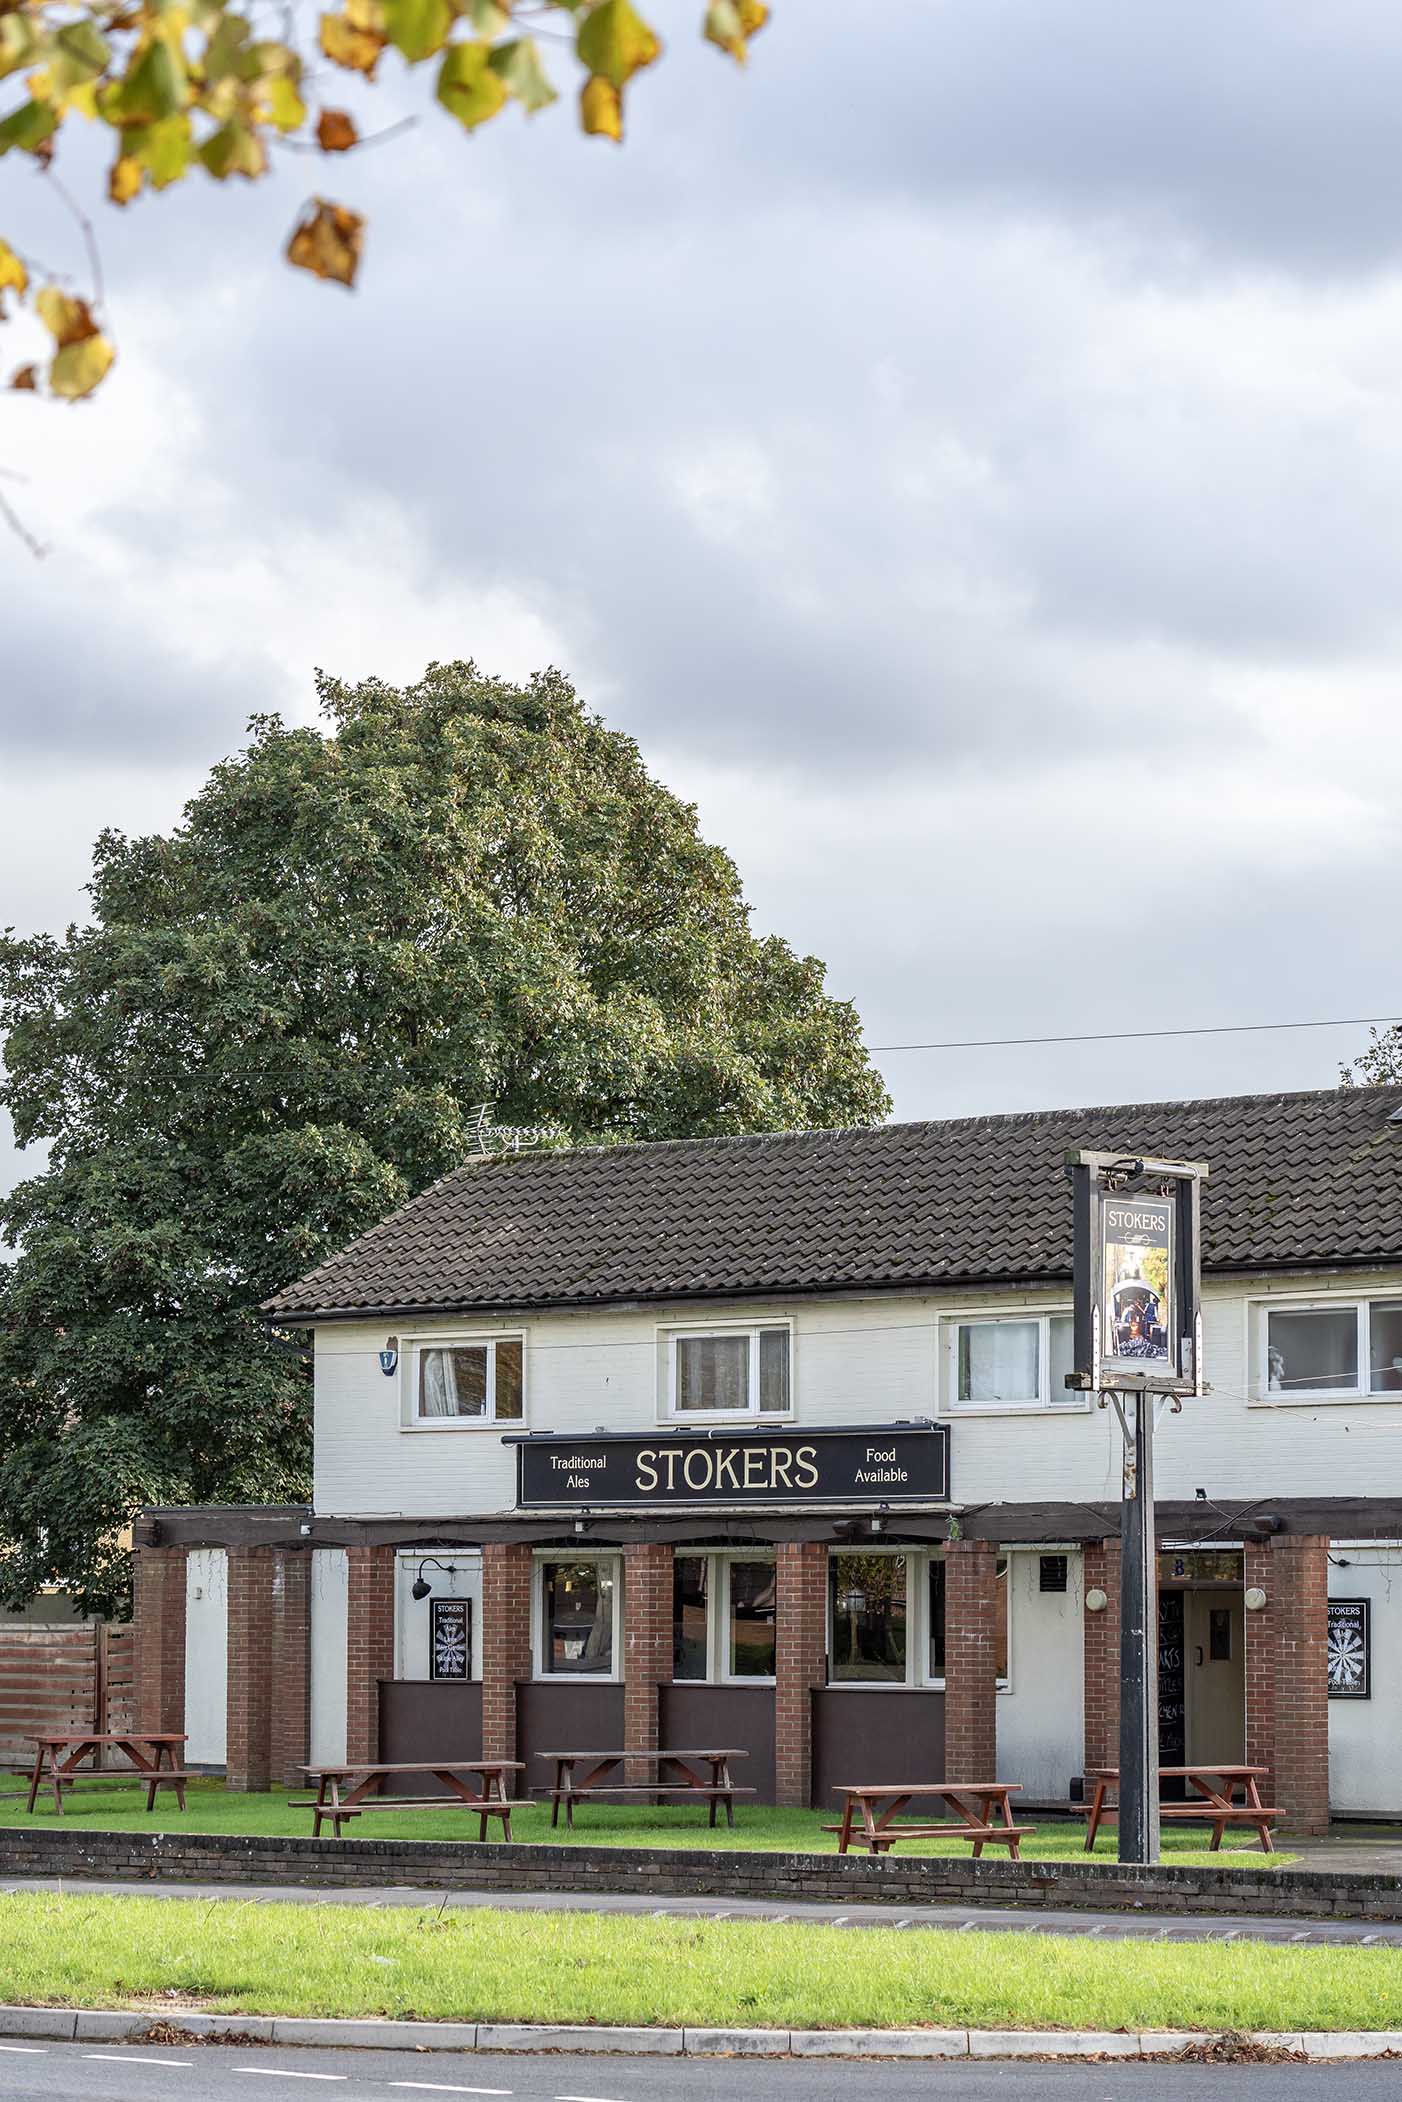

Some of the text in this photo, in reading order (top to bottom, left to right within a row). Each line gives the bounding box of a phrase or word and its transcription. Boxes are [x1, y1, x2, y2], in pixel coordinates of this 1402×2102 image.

[1108, 1210, 1166, 1232] STOKERS
[550, 1455, 607, 1470] Traditional
[866, 1449, 896, 1463] Food
[635, 1446, 819, 1491] STOKERS
[854, 1466, 908, 1483] Available
[566, 1473, 590, 1488] Ales
[437, 1605, 464, 1613] STOKERS
[438, 1616, 463, 1624] Traditional
